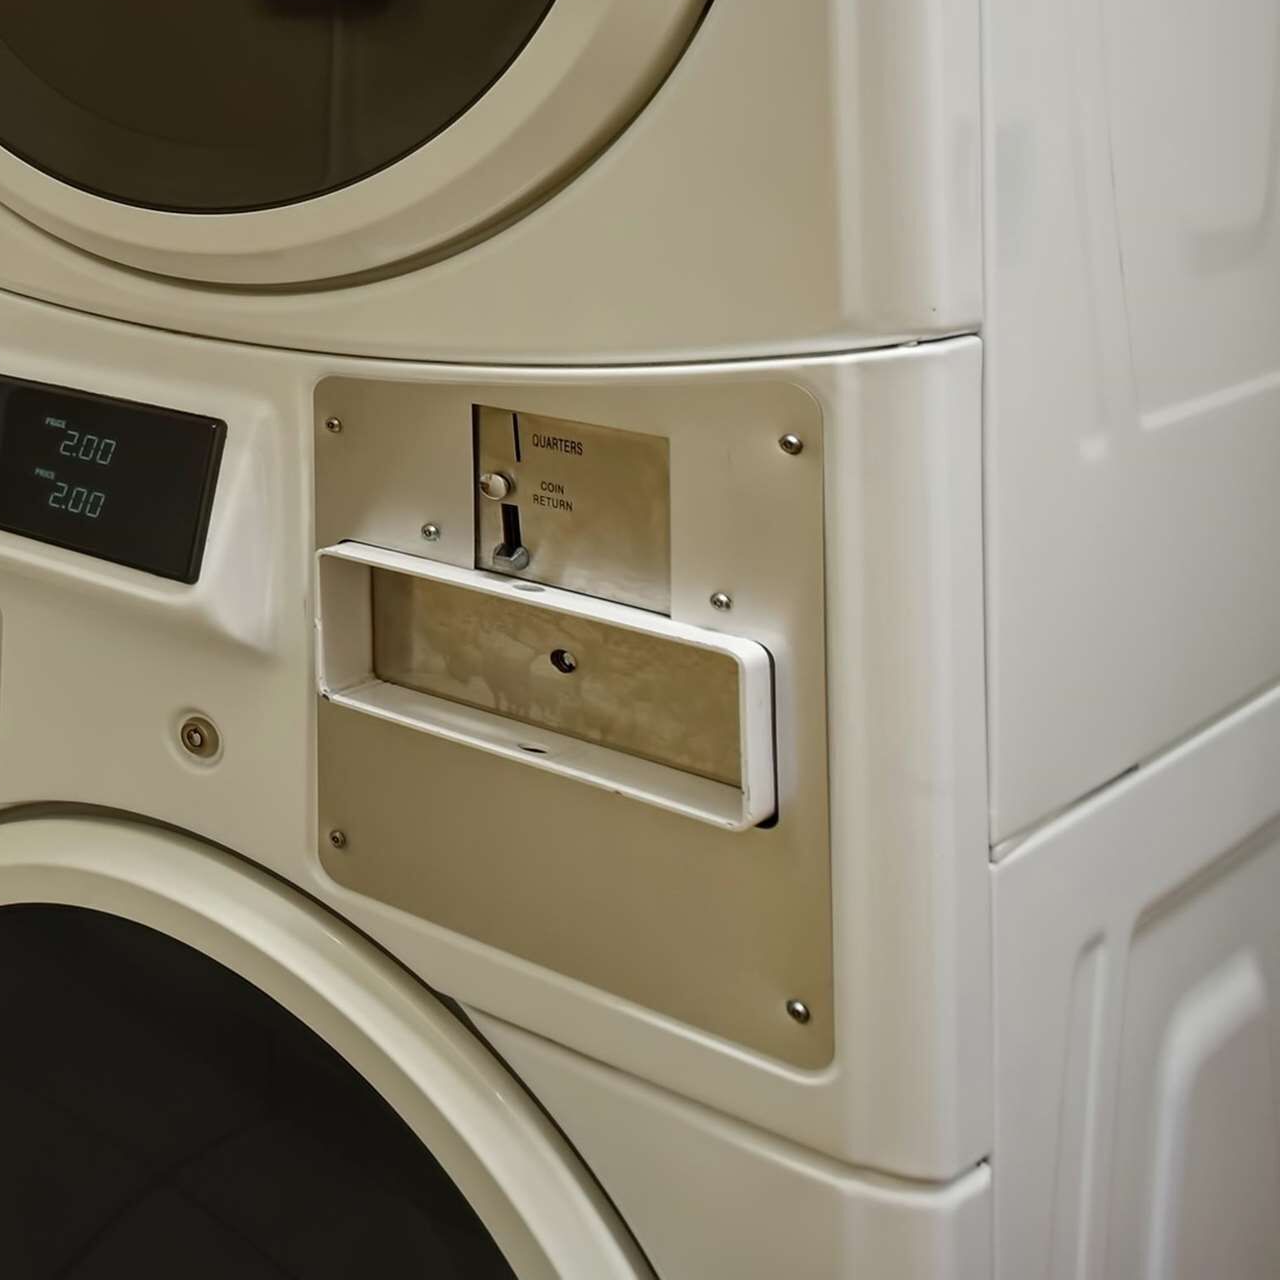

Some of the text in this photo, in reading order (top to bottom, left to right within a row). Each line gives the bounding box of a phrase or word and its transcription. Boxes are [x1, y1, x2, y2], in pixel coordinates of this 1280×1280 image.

[60, 430, 116, 464] 2.00
[532, 433, 583, 456] QUARTERS
[48, 481, 105, 518] 2.00
[541, 481, 565, 495] COIN
[533, 494, 573, 512] RETURN
